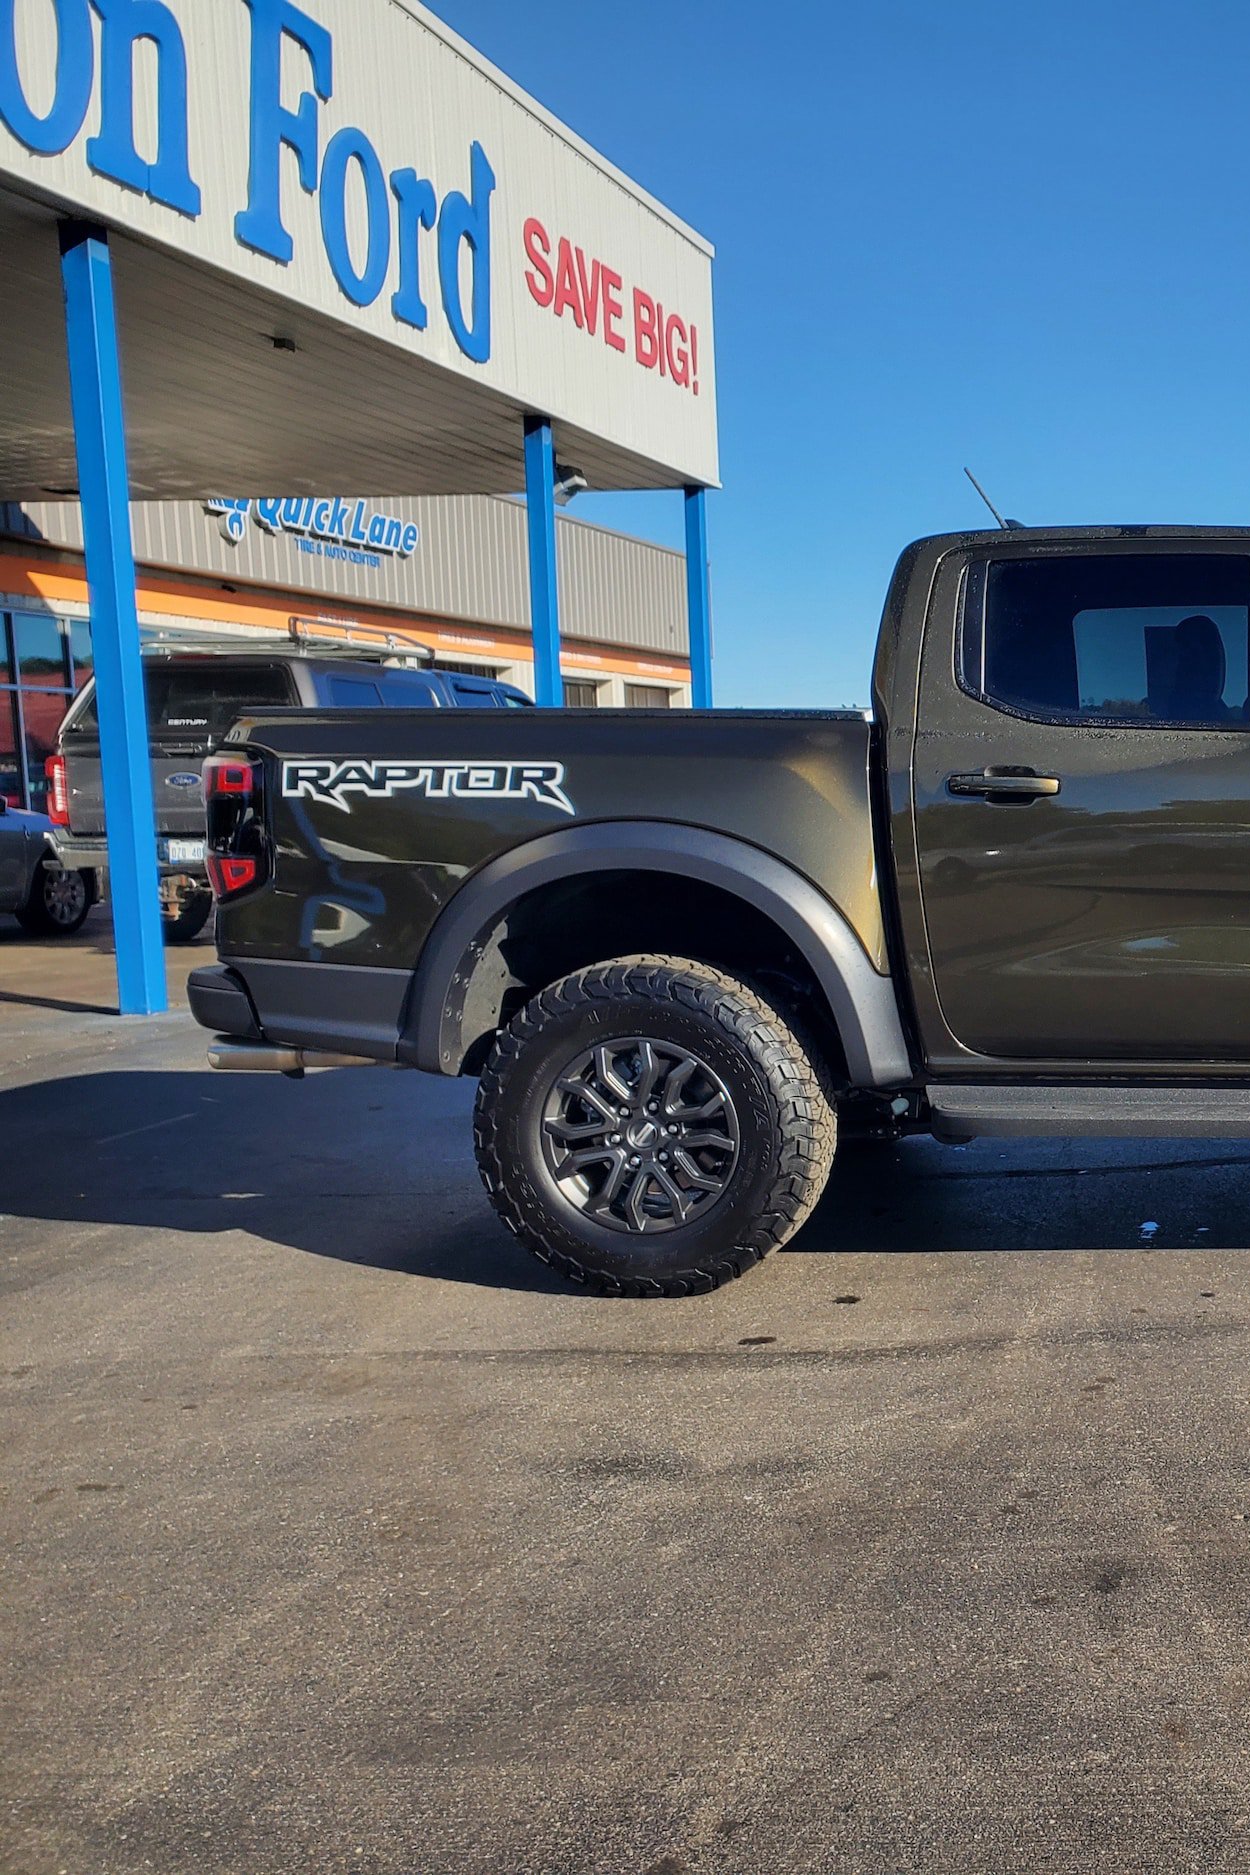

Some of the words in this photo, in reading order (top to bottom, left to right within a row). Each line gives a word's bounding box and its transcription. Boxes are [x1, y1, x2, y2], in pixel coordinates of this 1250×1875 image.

[234, 0, 496, 364] Ford
[522, 216, 626, 353] SAVE
[633, 286, 700, 396] BIG!
[256, 497, 351, 537] Quick
[351, 498, 419, 552] Lane
[293, 537, 315, 556] TIRE
[324, 543, 348, 561] AUTO
[349, 549, 381, 568] CENTER
[167, 718, 208, 726] CENTURY
[282, 760, 576, 817] RAPTOR
